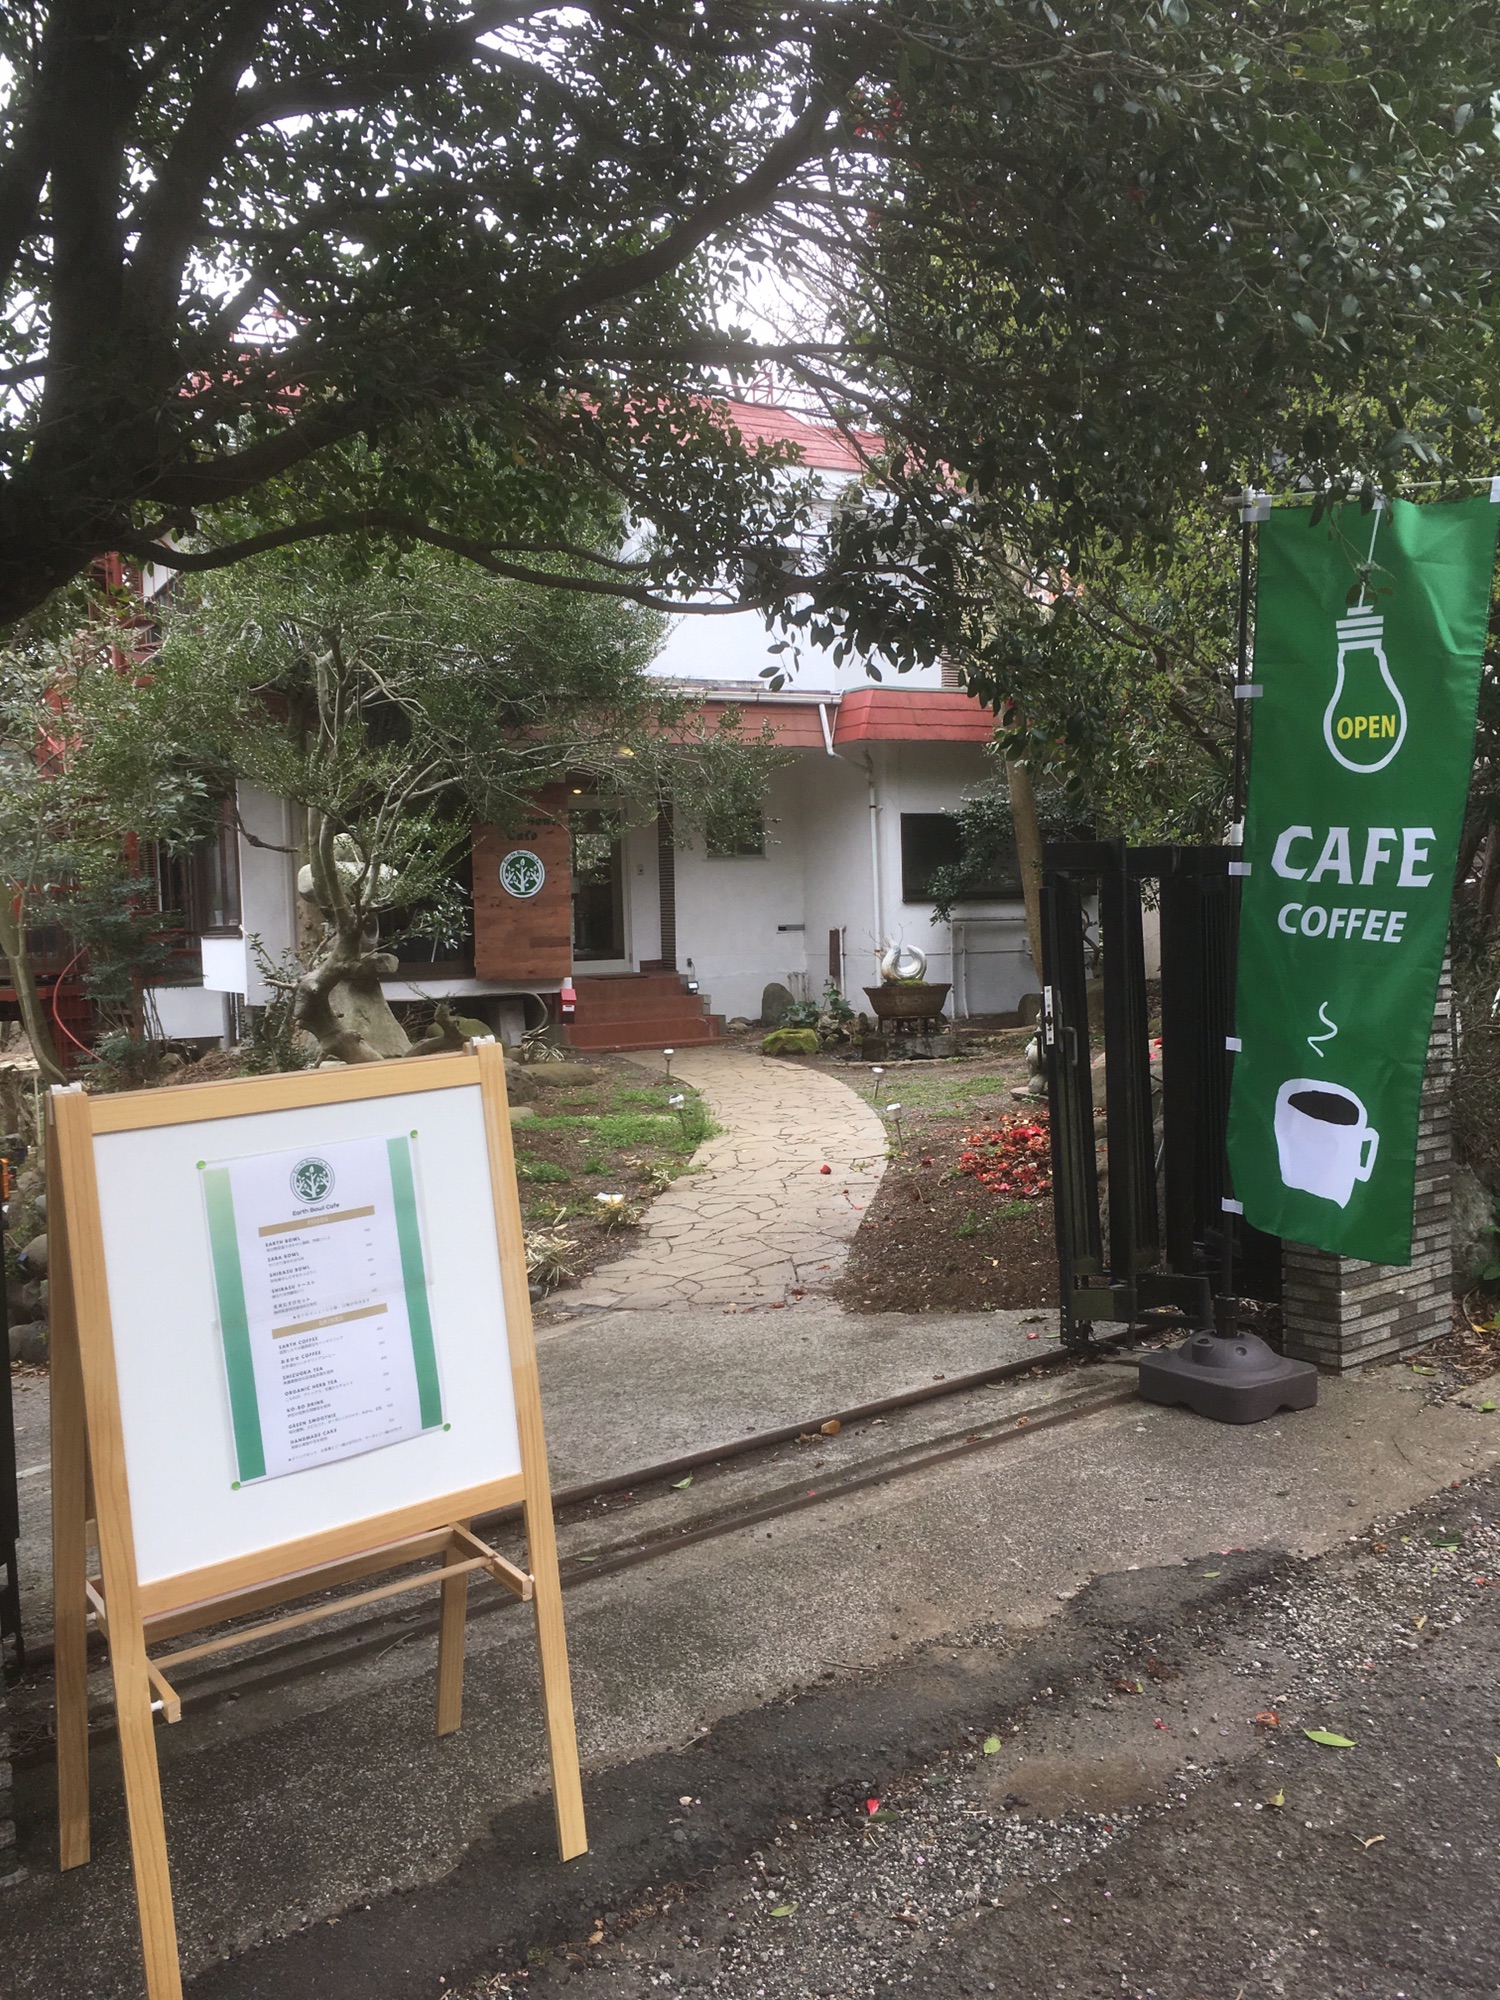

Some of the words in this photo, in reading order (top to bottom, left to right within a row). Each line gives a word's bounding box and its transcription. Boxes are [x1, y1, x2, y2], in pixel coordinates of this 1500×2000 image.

[1337, 714, 1396, 739] OPEN
[1271, 825, 1437, 887] CAFE
[1278, 903, 1407, 942] COFFEE
[292, 1208, 309, 1216] Earth
[326, 1202, 340, 1210] Cafe
[279, 1341, 296, 1350] EARTH
[298, 1336, 318, 1345] COFFEE
[301, 1350, 321, 1359] COFFEE
